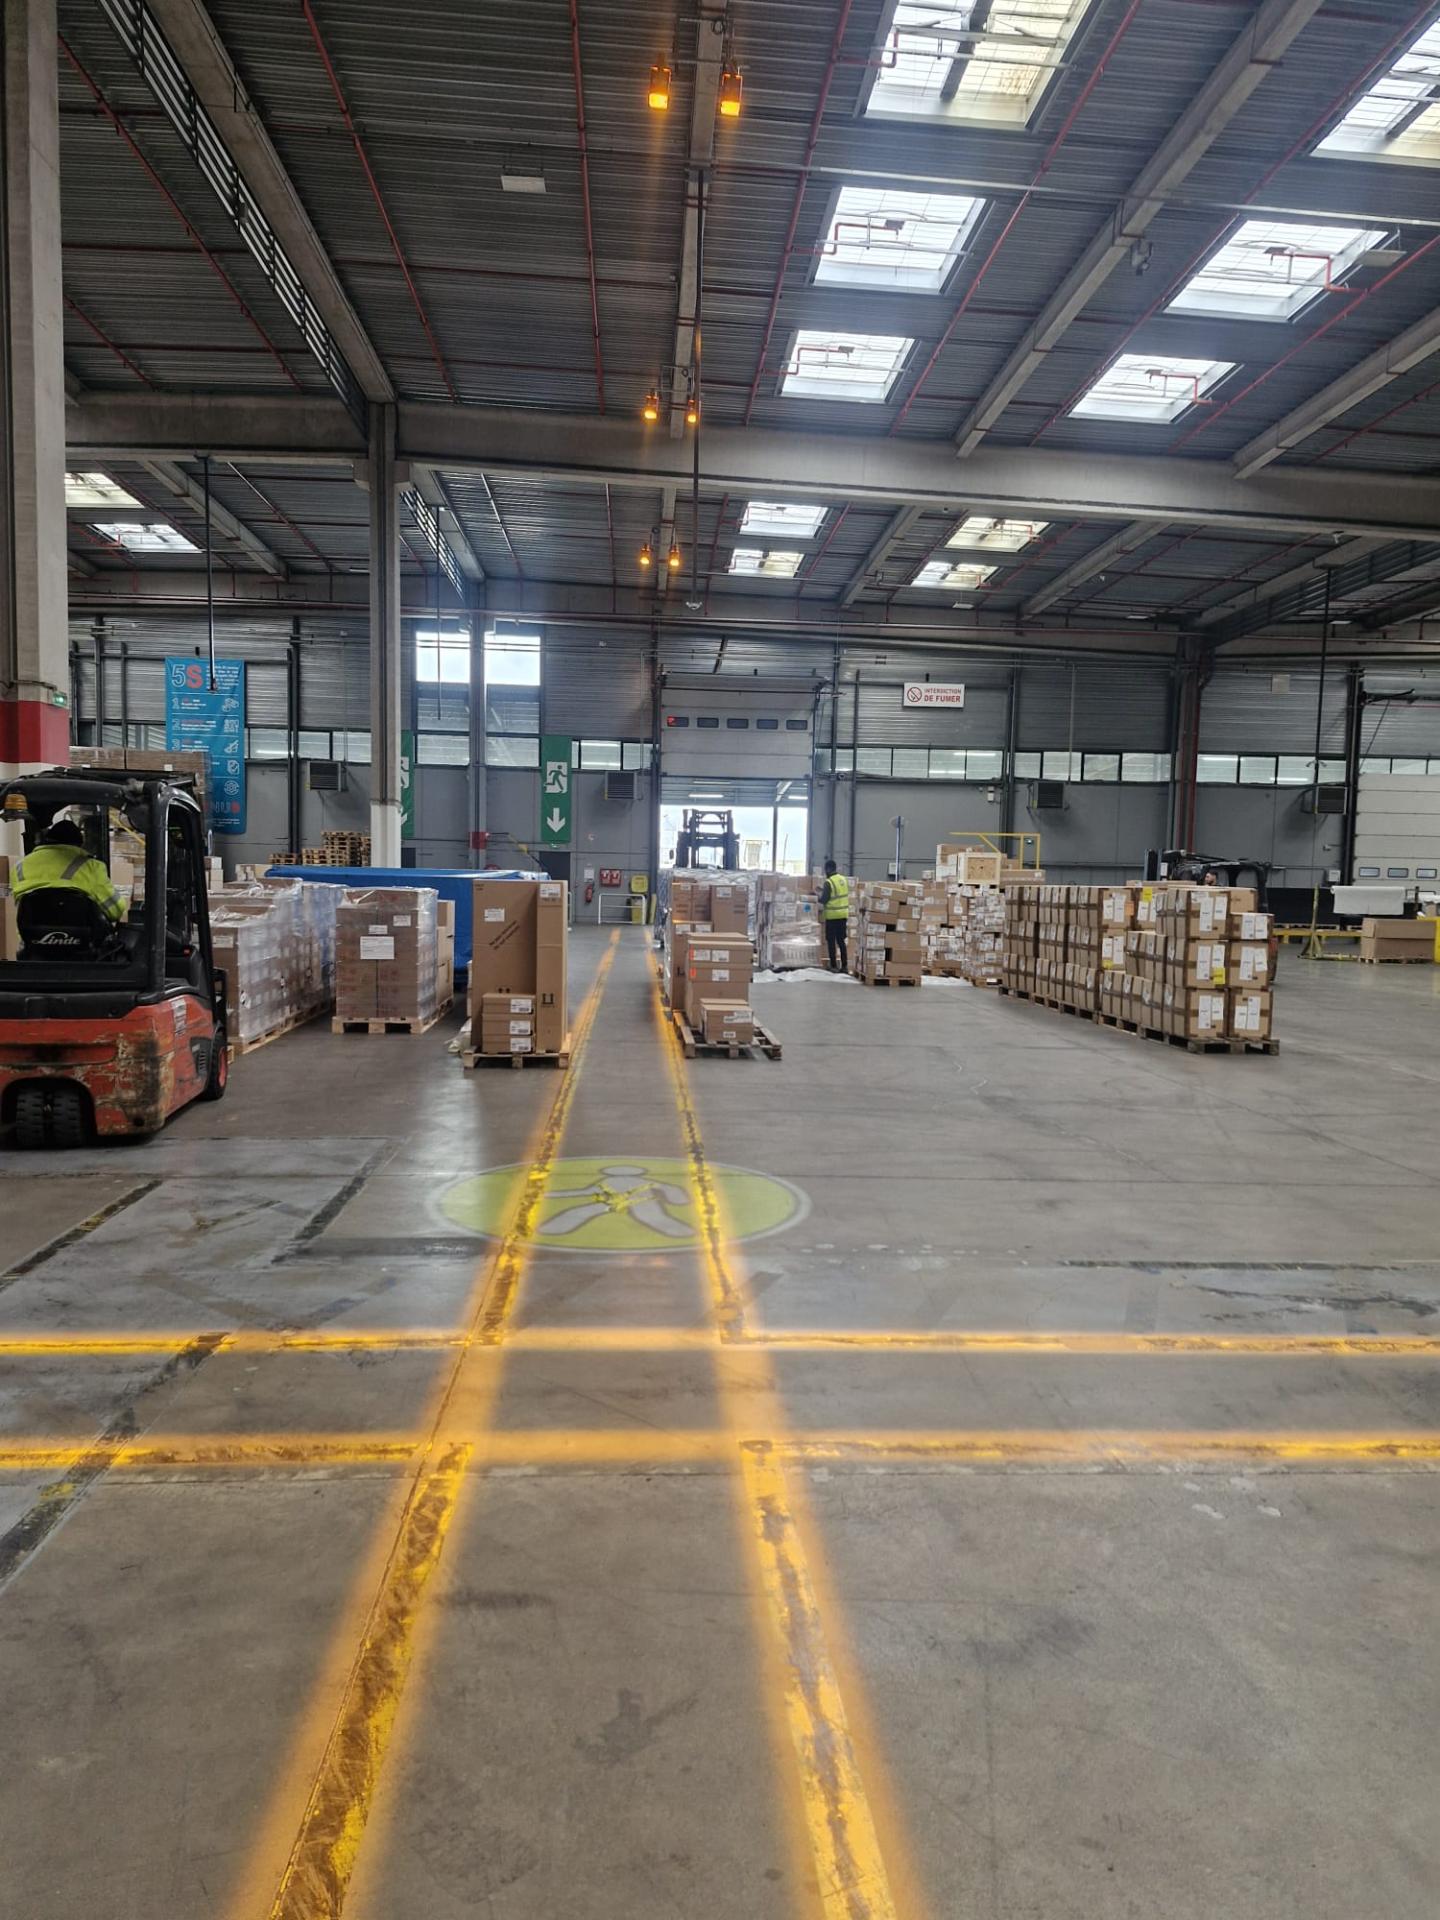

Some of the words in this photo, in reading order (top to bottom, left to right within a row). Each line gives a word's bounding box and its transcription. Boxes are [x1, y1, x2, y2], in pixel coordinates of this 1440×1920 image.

[171, 663, 203, 688] 5S
[935, 695, 961, 703] FUMER
[32, 931, 81, 945] Linde
